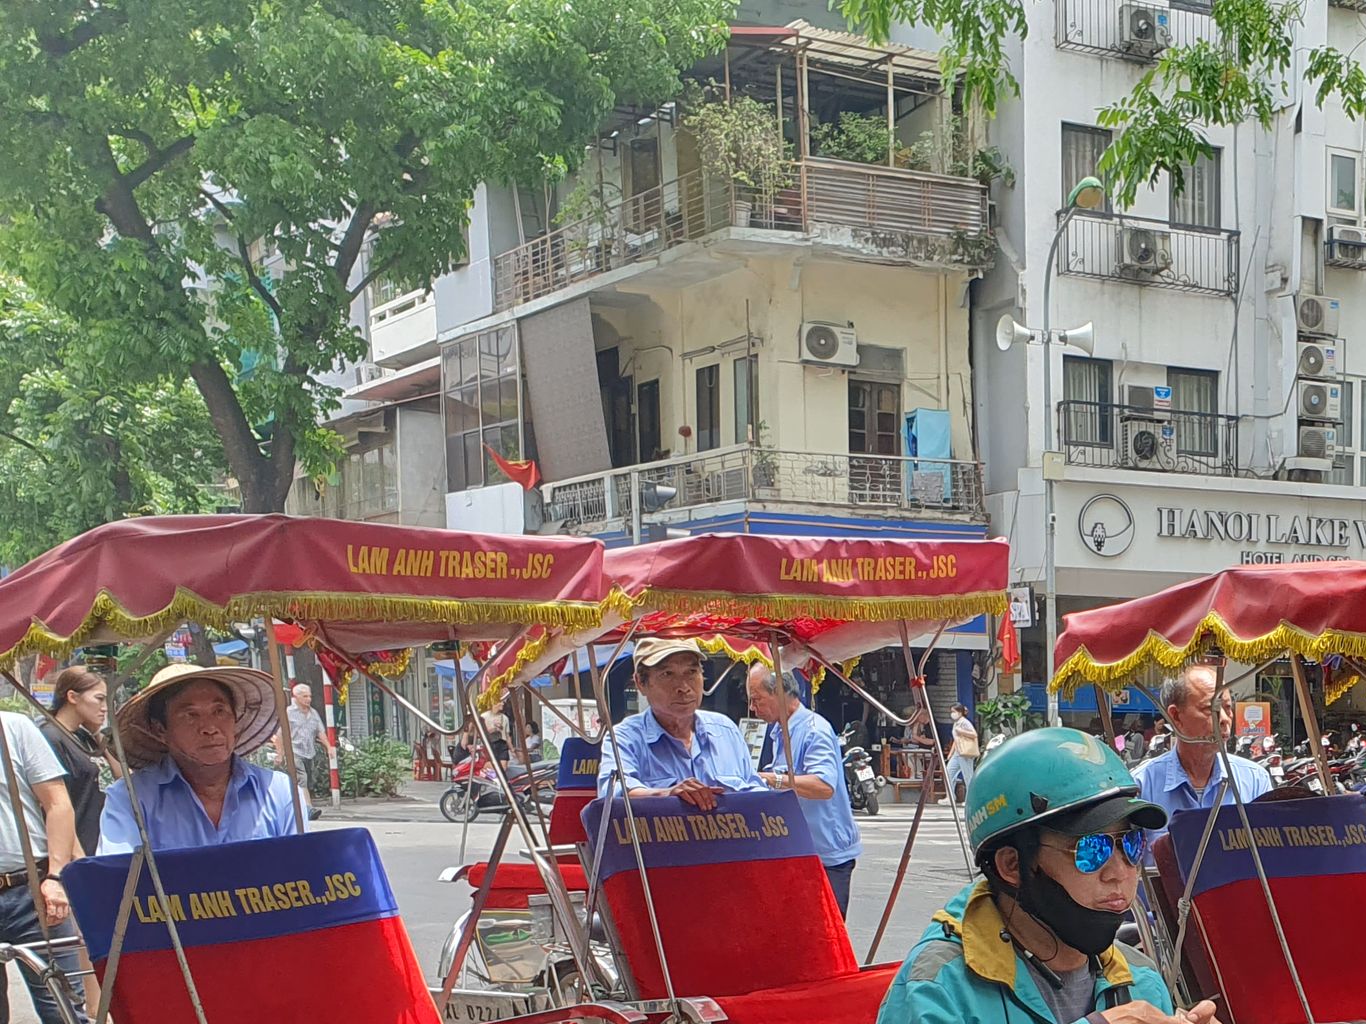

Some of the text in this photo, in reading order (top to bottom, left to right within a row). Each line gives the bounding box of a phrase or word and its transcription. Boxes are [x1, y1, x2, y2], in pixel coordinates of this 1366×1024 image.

[1157, 507, 1260, 542] HANOI
[1266, 514, 1349, 547] LAKE
[346, 544, 390, 576] LAM
[392, 548, 434, 578] ANH
[780, 557, 819, 583] LAM
[822, 557, 854, 583] ANH
[655, 813, 690, 843] ANH
[1253, 825, 1285, 849] ANH
[133, 894, 188, 924] LAM
[190, 889, 238, 920] ANH
